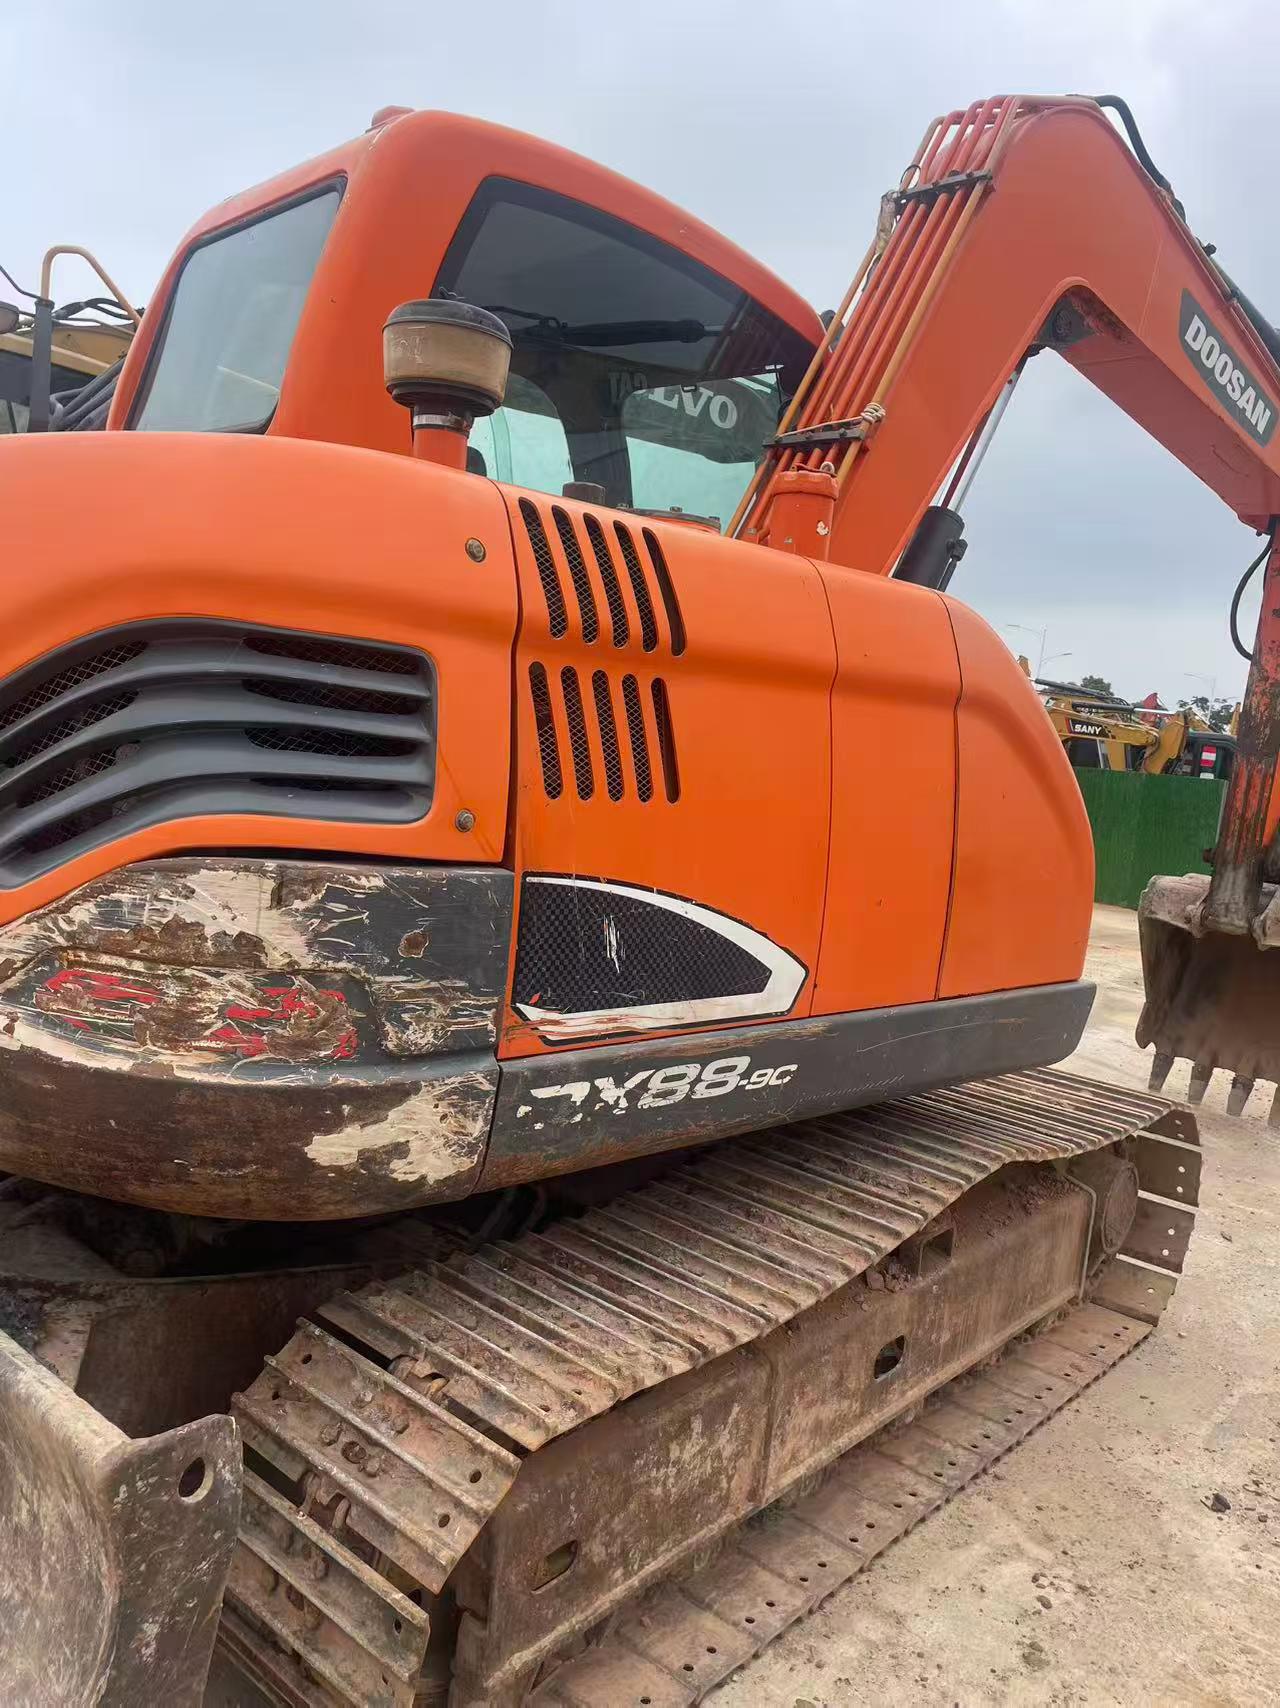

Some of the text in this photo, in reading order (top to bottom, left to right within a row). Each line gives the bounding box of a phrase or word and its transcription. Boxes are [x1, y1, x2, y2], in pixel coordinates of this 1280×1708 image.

[1184, 314, 1271, 435] DOOSAN
[634, 384, 738, 429] LVO
[1074, 724, 1102, 735] SANY
